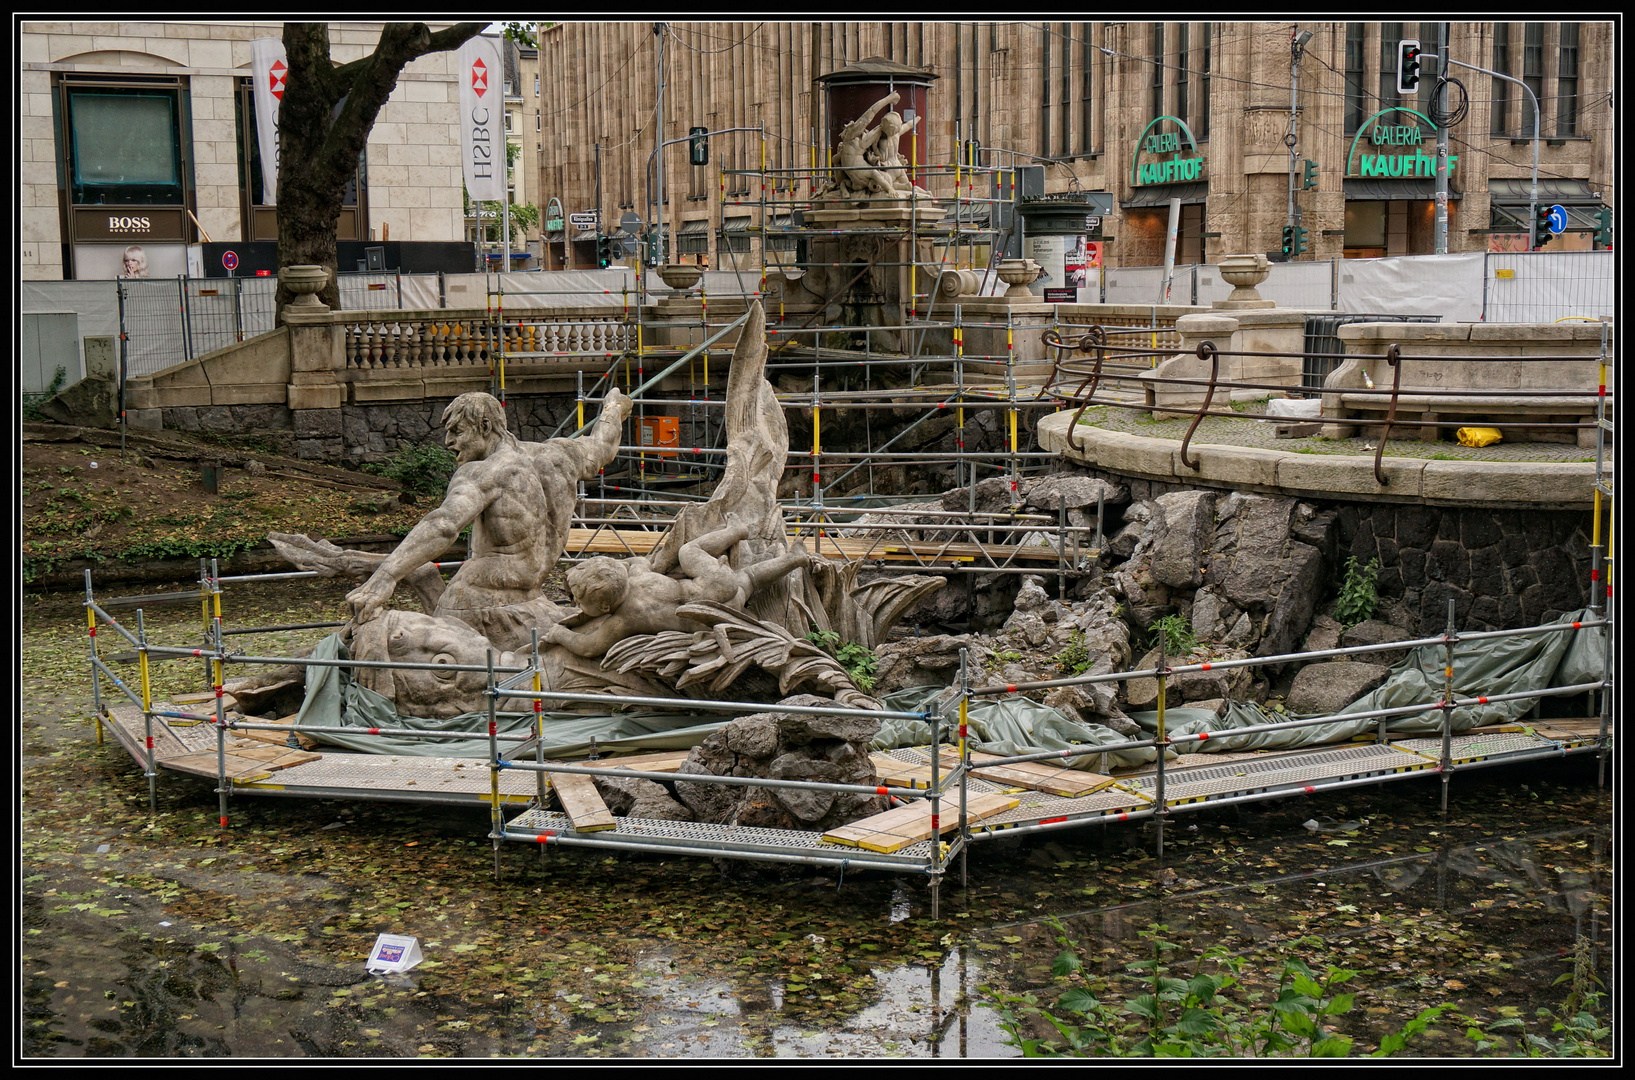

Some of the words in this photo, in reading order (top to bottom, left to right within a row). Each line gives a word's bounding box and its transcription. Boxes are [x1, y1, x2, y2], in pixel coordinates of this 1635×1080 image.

[1146, 132, 1179, 154] GALERIA
[1373, 125, 1422, 145] GALERIA
[109, 216, 151, 229] BOSS
